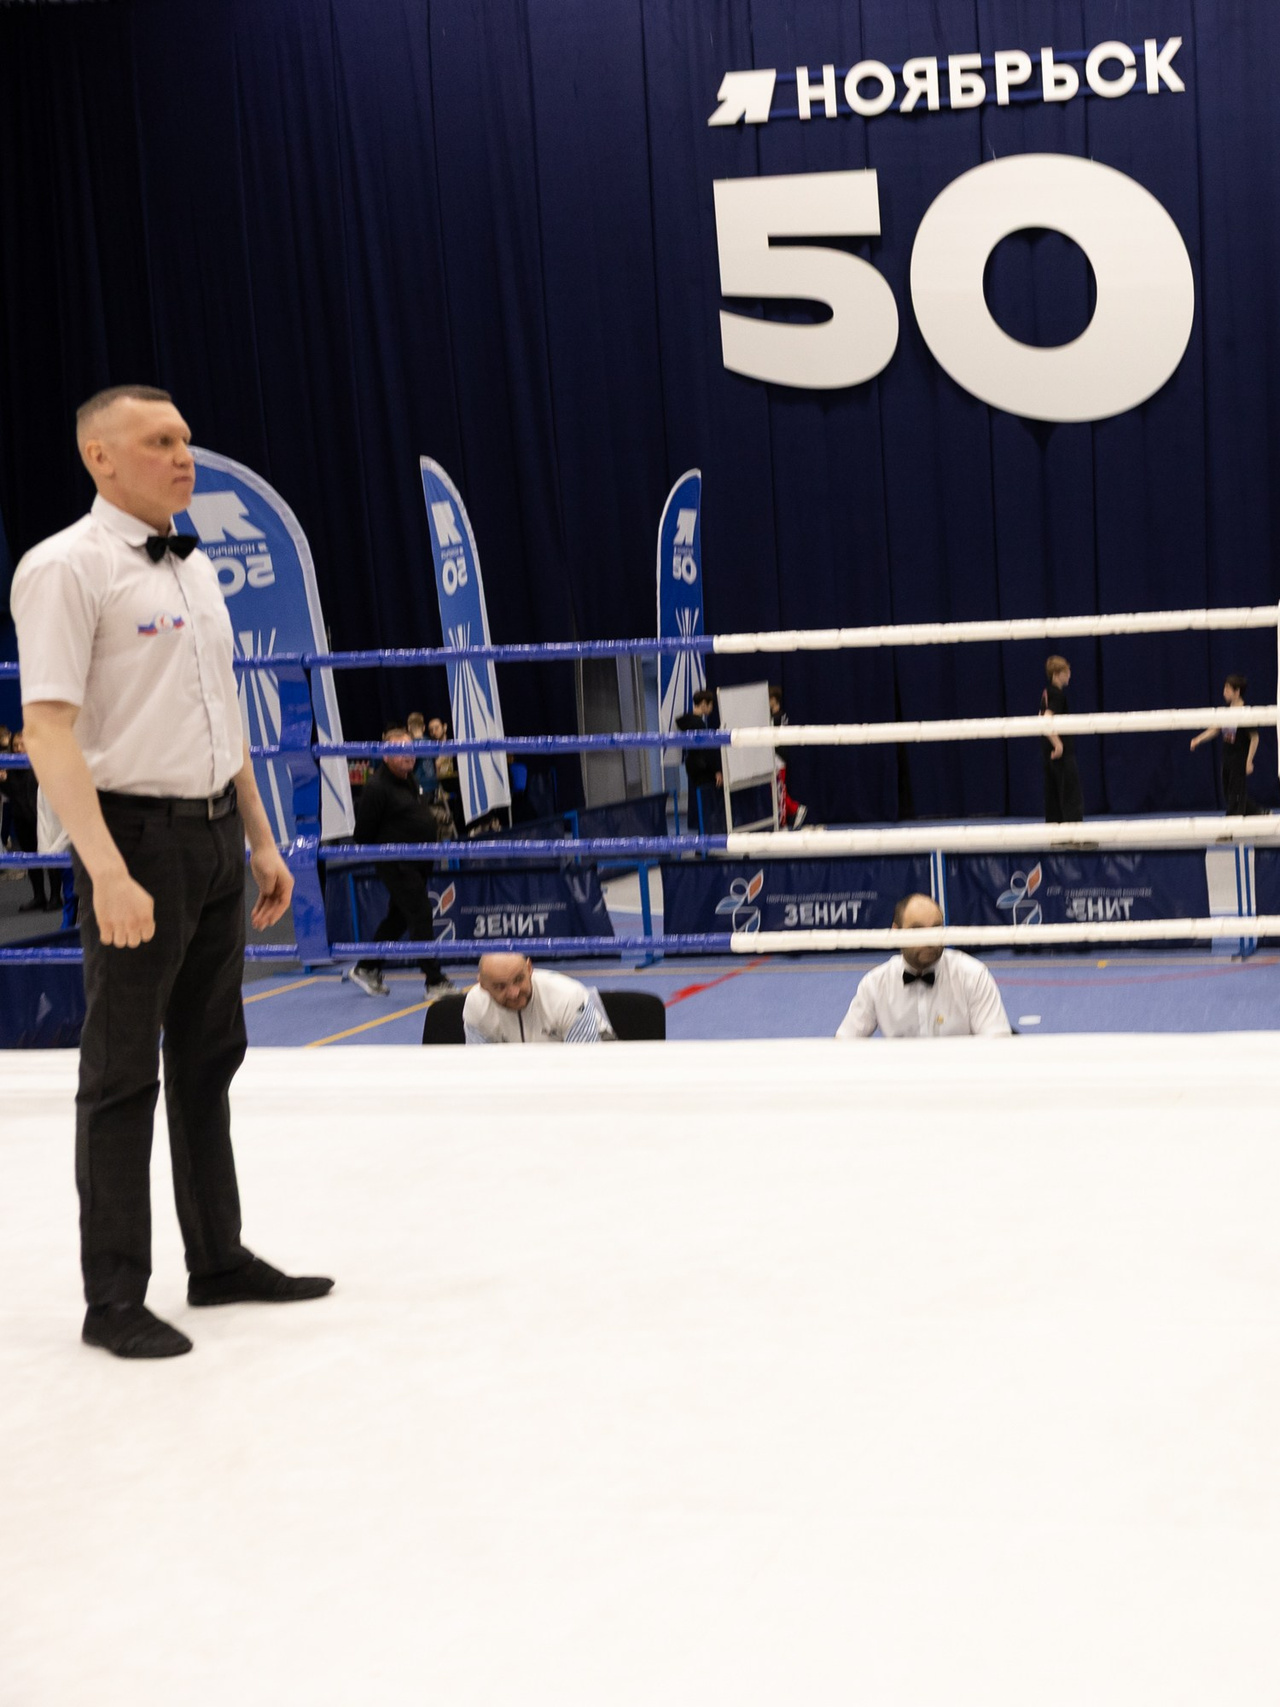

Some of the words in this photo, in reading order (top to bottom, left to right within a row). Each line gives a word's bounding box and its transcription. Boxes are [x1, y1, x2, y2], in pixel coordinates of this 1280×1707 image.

[796, 36, 1186, 120] НОЯБРЬСК
[713, 152, 1195, 423] 50
[672, 555, 697, 585] 50
[473, 912, 549, 938] ЗЕНИТ
[784, 900, 862, 927] ЗЕНИТ
